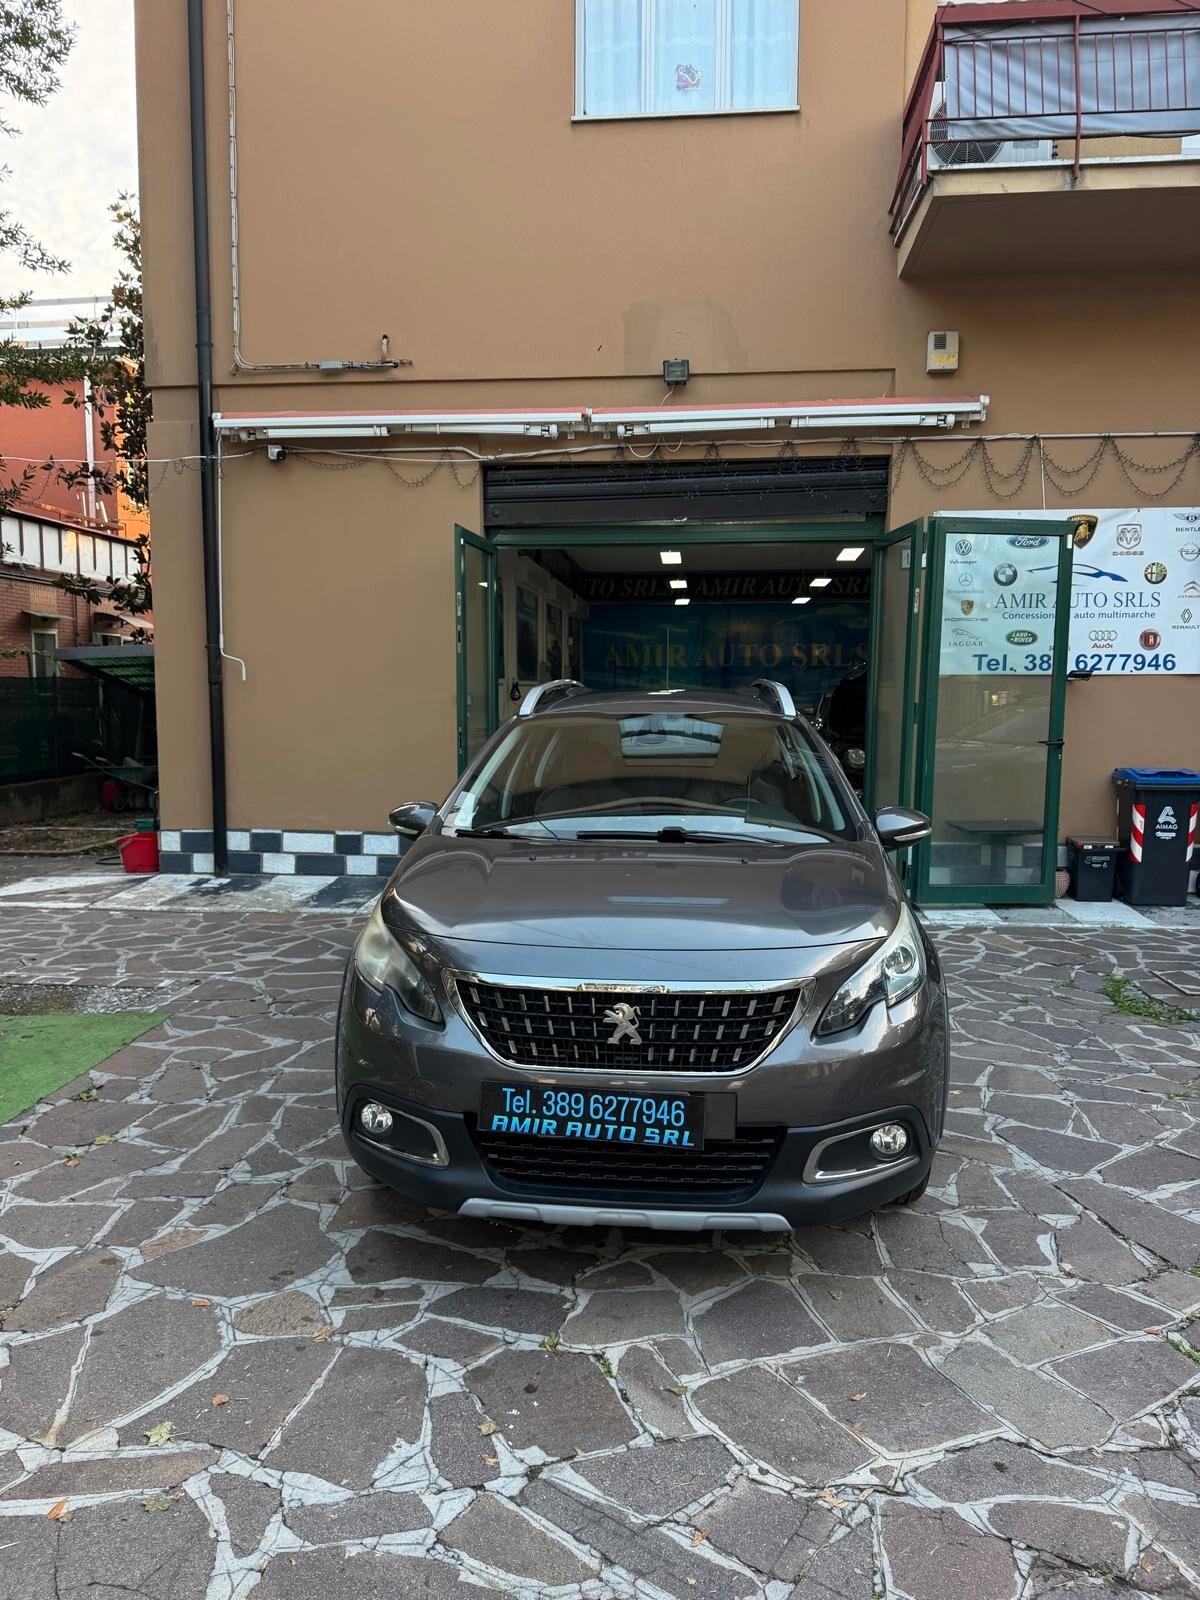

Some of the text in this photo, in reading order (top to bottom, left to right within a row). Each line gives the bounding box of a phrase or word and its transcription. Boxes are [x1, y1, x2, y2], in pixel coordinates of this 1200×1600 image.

[1015, 536, 1041, 547] Ford
[694, 576, 758, 596] AMIR
[994, 591, 1161, 609] AMIR UTO SRLS
[1002, 610, 1156, 620] Concession auto multimarche
[603, 643, 689, 668] AMIR
[695, 643, 784, 668] AUTO
[972, 653, 1177, 672] Tel. 38 6277946
[502, 1087, 685, 1127] Tel. 389 6277946
[491, 1114, 695, 1147] AMIR AUTO SRL
